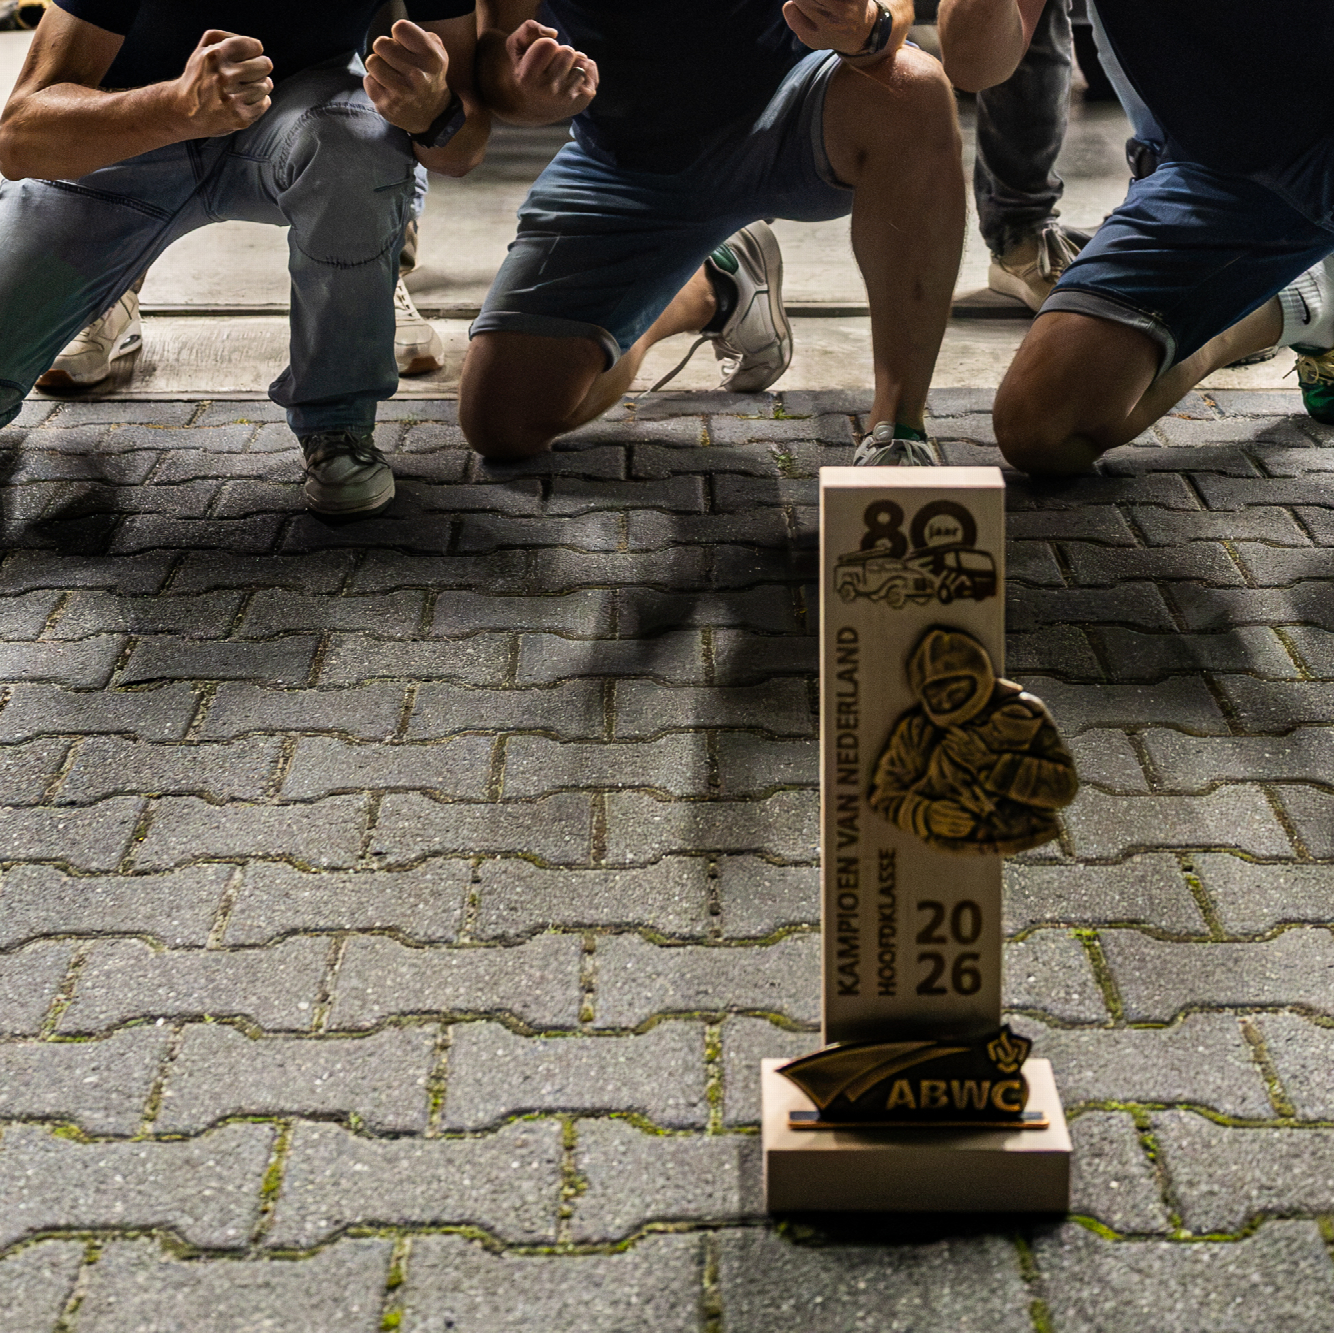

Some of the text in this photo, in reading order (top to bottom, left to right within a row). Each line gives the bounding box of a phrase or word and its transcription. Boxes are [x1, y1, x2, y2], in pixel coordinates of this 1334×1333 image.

[860, 498, 978, 560] 80
[836, 626, 860, 997] KAMPIOEN VAN NEDERLAND
[877, 847, 897, 997] HOOFDKLASSE
[916, 899, 983, 946] 20
[916, 951, 983, 996] 26
[885, 1078, 1023, 1113] ABWC
